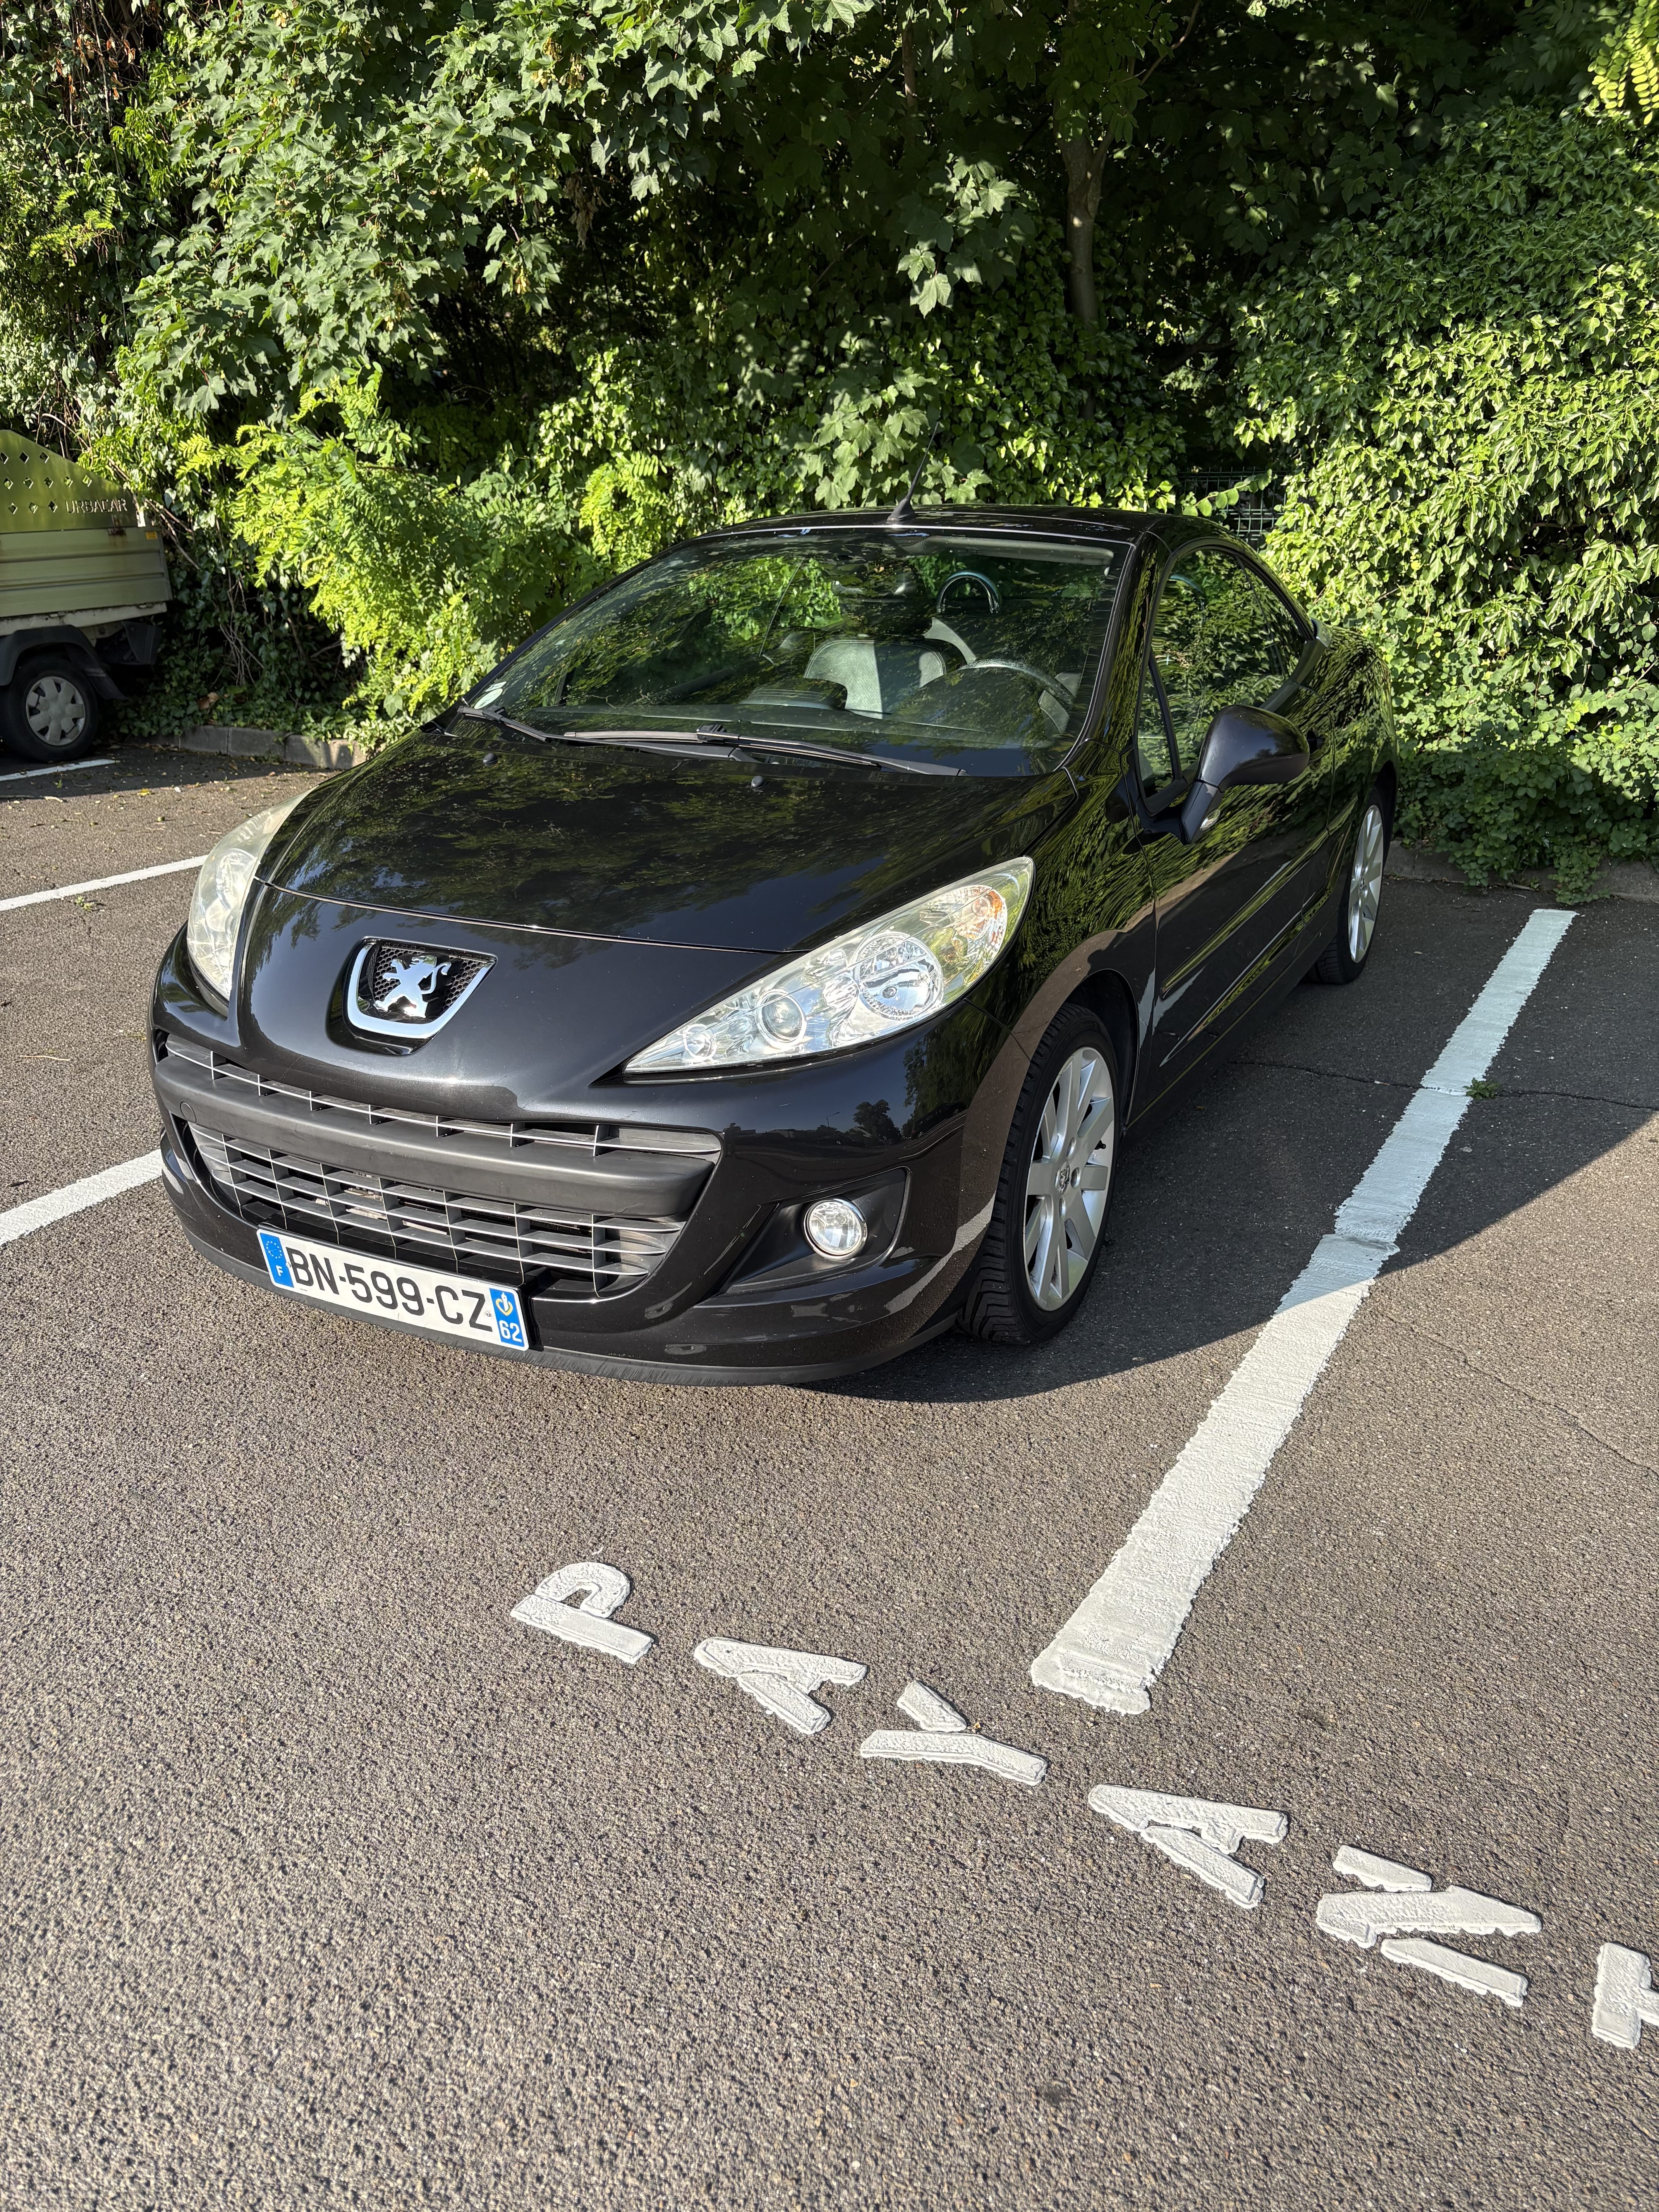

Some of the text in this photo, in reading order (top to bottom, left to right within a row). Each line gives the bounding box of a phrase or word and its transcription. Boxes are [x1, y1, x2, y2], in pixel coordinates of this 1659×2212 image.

[66, 498, 127, 513] URBACAR
[276, 1265, 283, 1276] F
[285, 1247, 493, 1332] BN-599-CZ
[499, 1320, 522, 1343] 62
